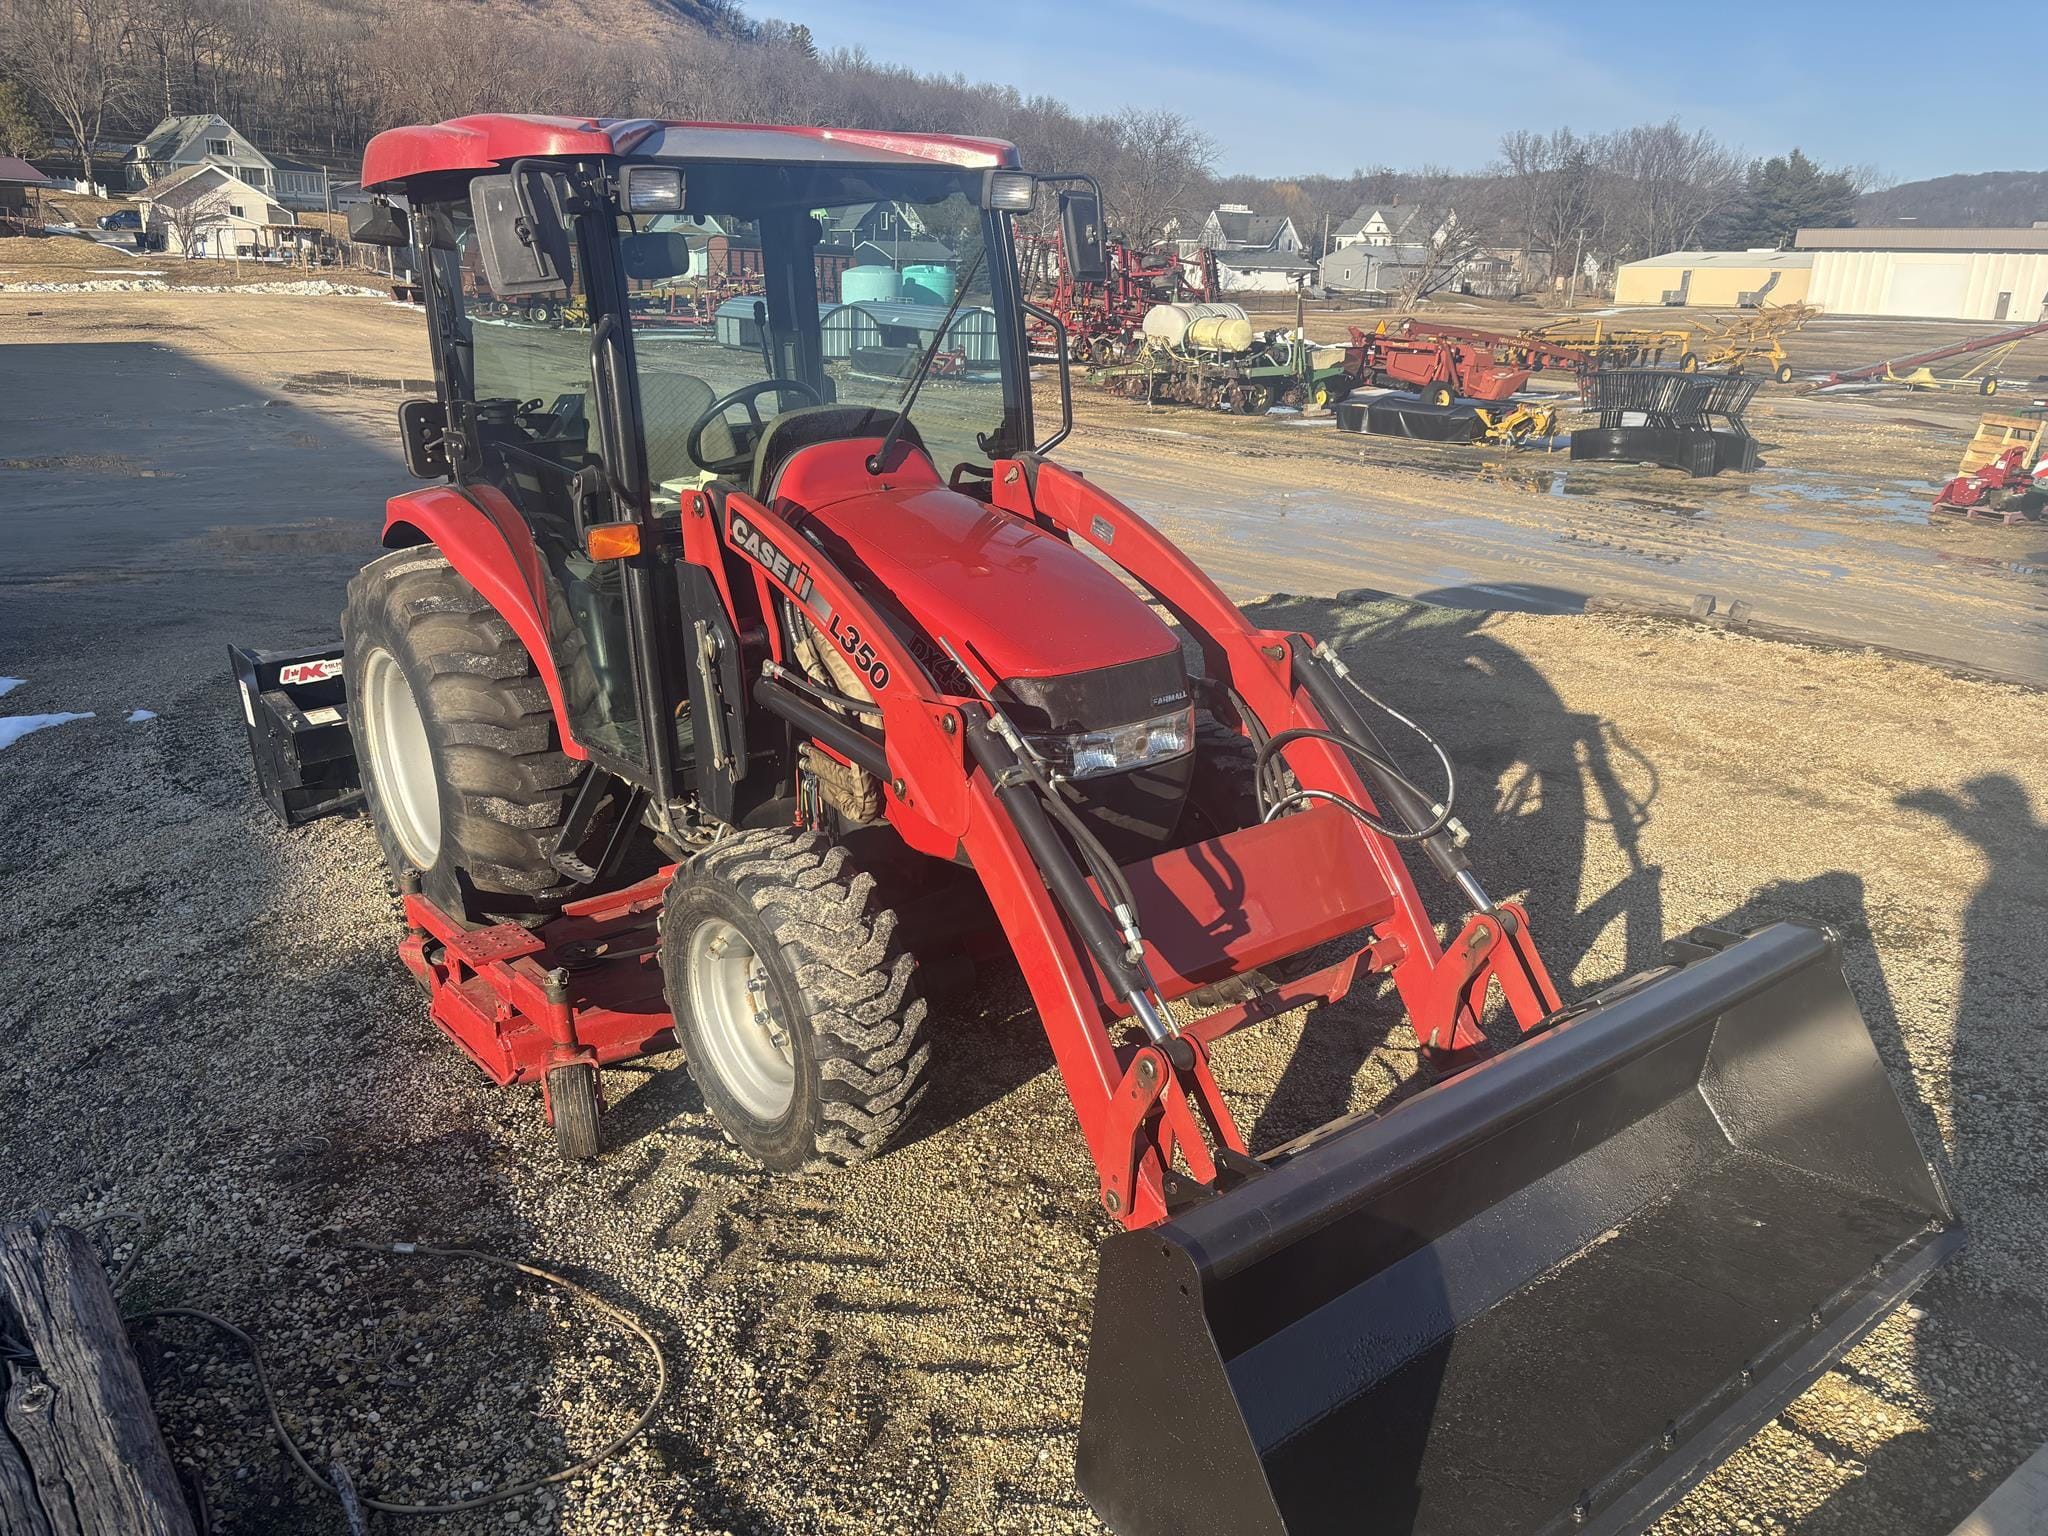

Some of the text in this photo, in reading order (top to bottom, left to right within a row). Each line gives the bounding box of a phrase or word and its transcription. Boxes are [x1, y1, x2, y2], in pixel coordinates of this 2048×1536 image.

[731, 518, 790, 578] CASE
[828, 615, 890, 690] L350
[1153, 690, 1187, 704] FARMALL
